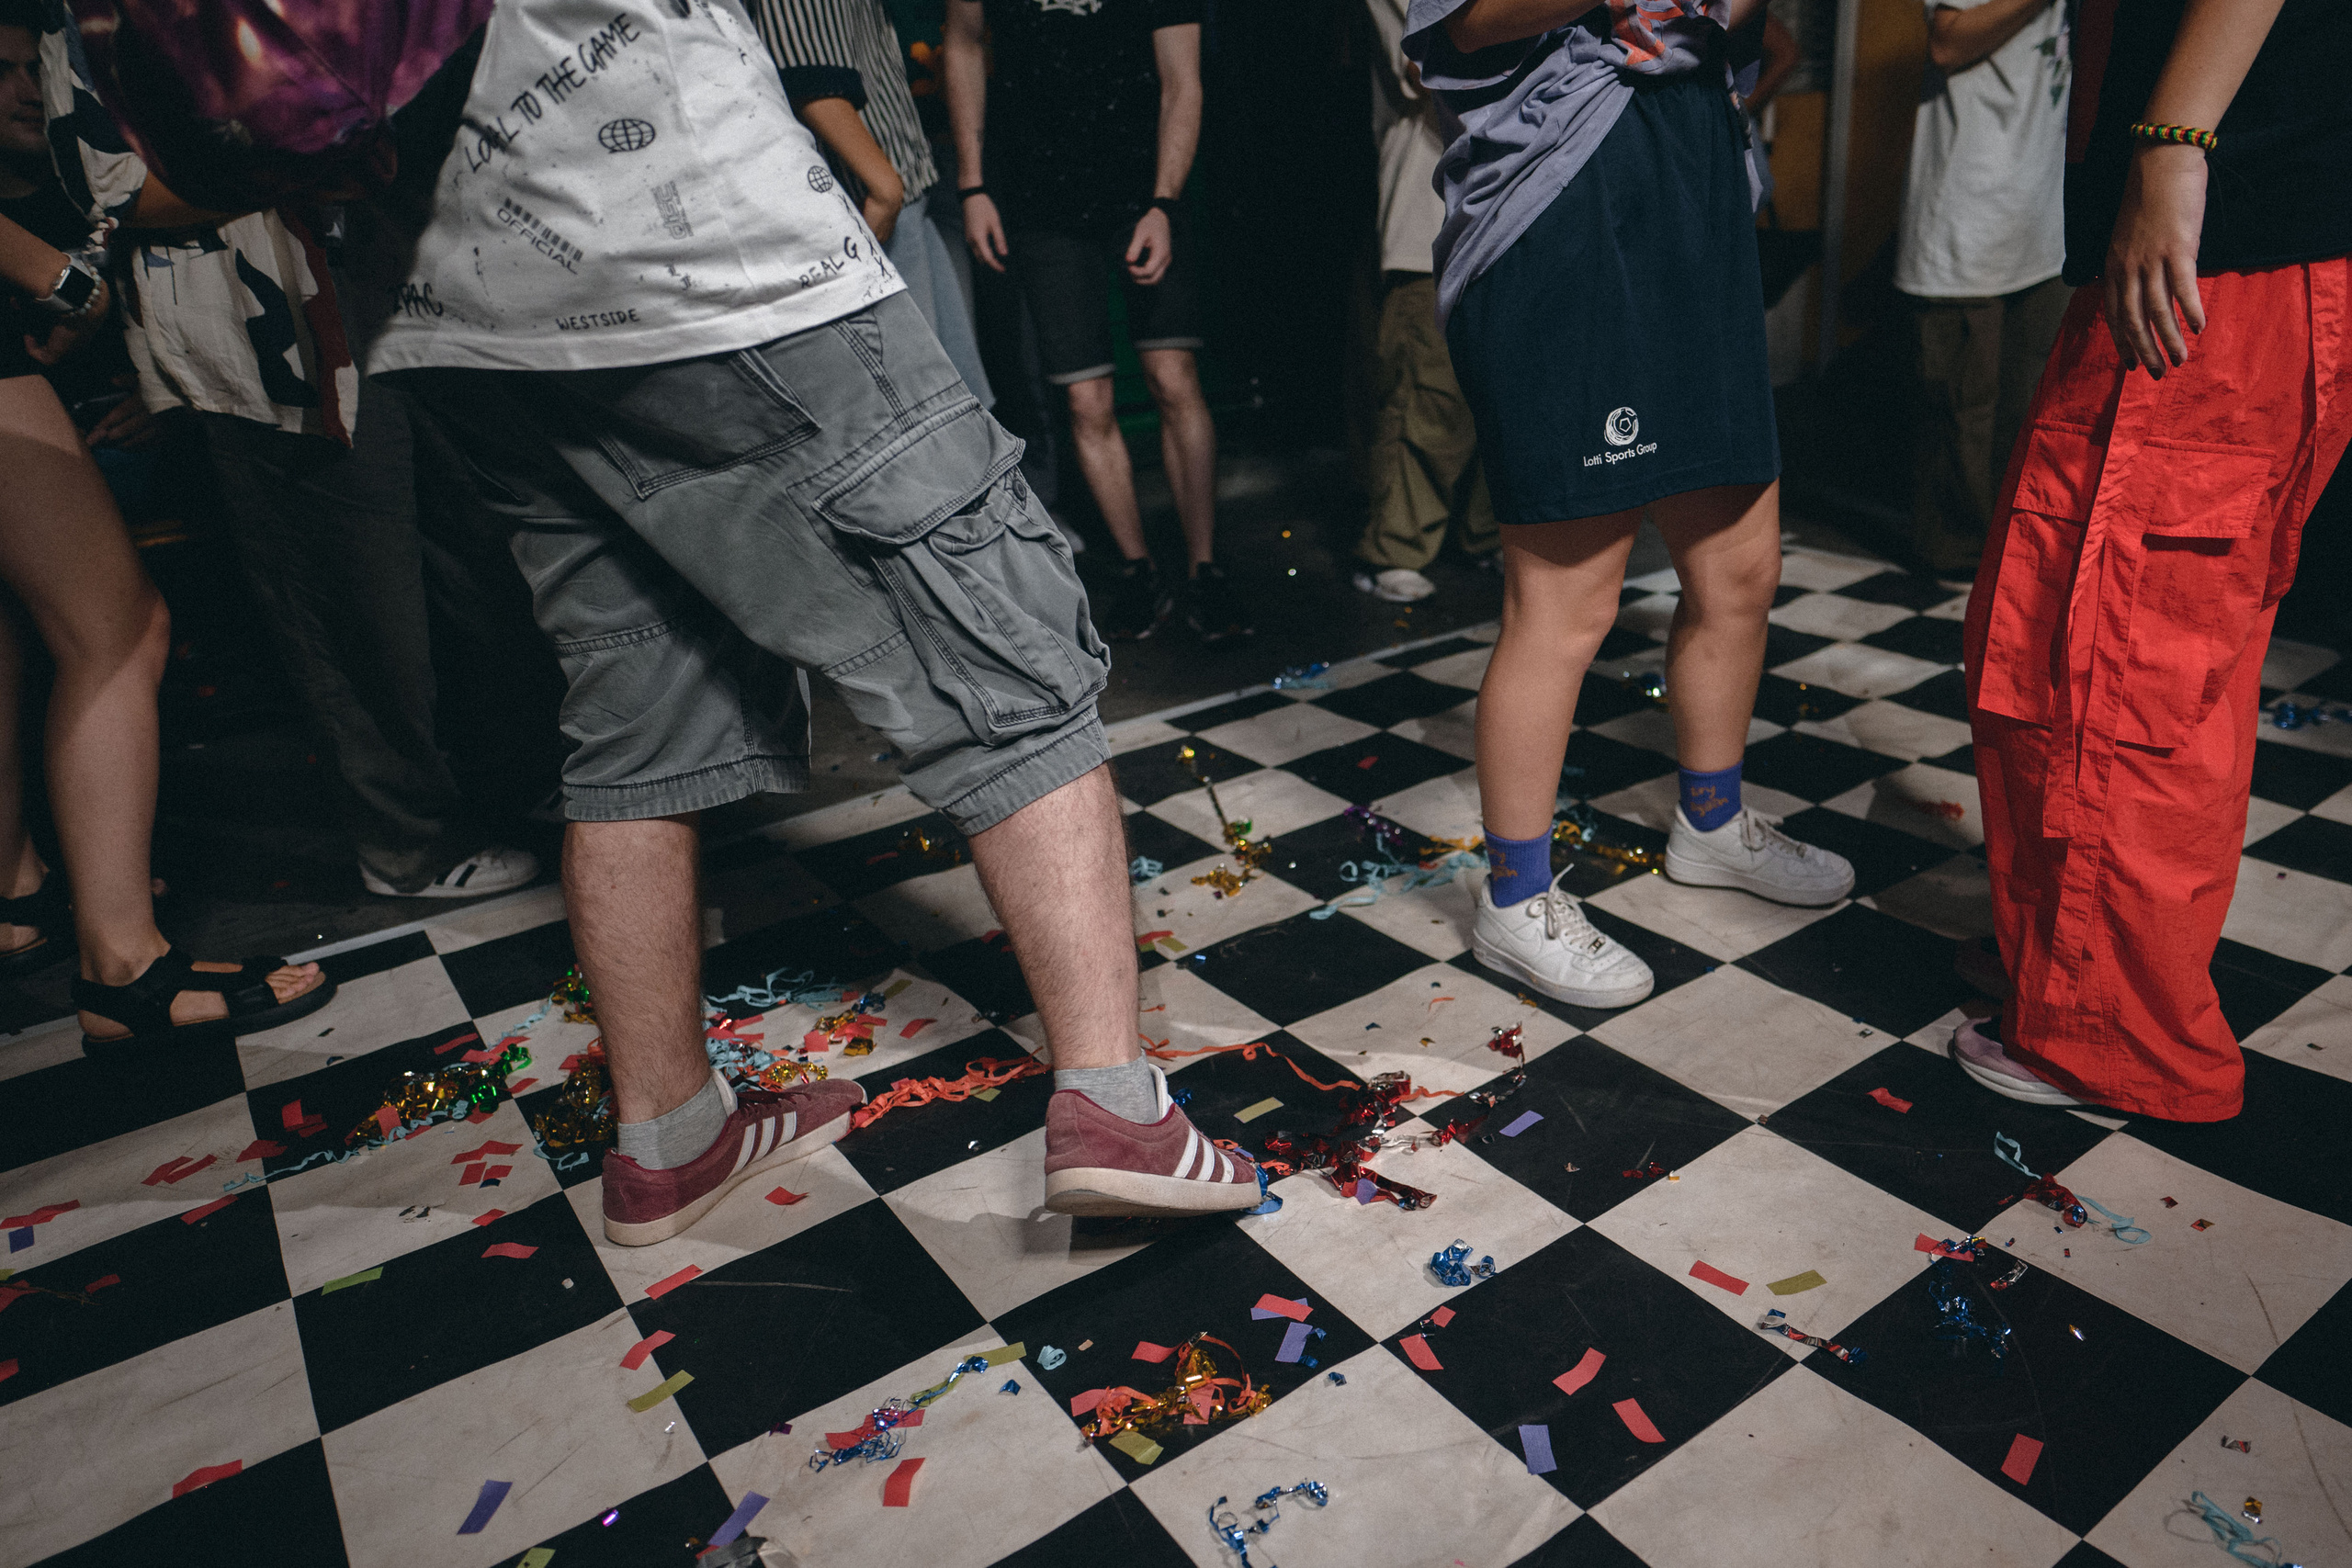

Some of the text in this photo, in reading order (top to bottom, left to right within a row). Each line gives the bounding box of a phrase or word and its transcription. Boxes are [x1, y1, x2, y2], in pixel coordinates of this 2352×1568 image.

[464, 13, 640, 174] LOAL TO THE GAME
[497, 208, 578, 276] OFFICIAL
[798, 235, 862, 288] REAL G
[555, 310, 640, 331] WESTSIDE
[1583, 442, 1657, 467] Lotti Sports Group
